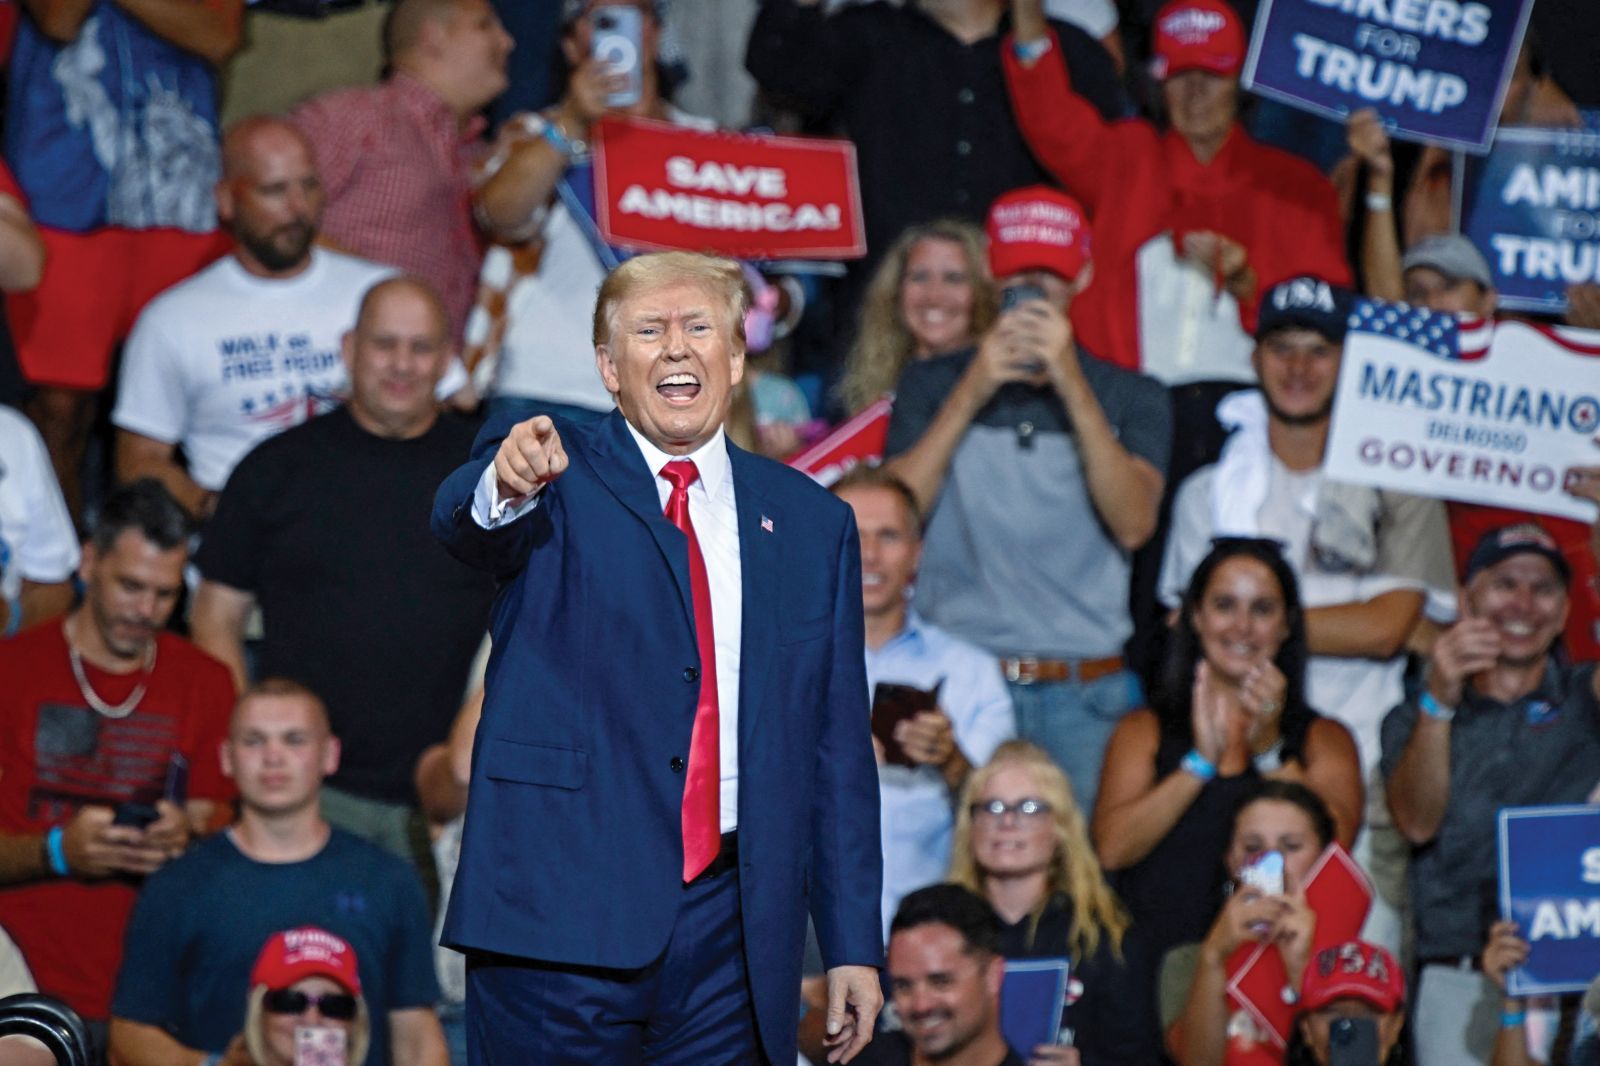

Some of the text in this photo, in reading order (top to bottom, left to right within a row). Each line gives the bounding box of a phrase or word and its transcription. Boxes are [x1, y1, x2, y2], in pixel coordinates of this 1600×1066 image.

[1303, 0, 1492, 45] KERS
[1356, 22, 1421, 60] FOR
[1293, 32, 1467, 113] TRUMP
[665, 155, 787, 198] SAVE
[618, 184, 842, 232] AMERICA!
[1552, 210, 1600, 240] FO
[1491, 233, 1600, 284] TRU
[1273, 276, 1335, 313] USA
[1359, 361, 1600, 434] MASTRIANO
[1318, 942, 1389, 985] USA
